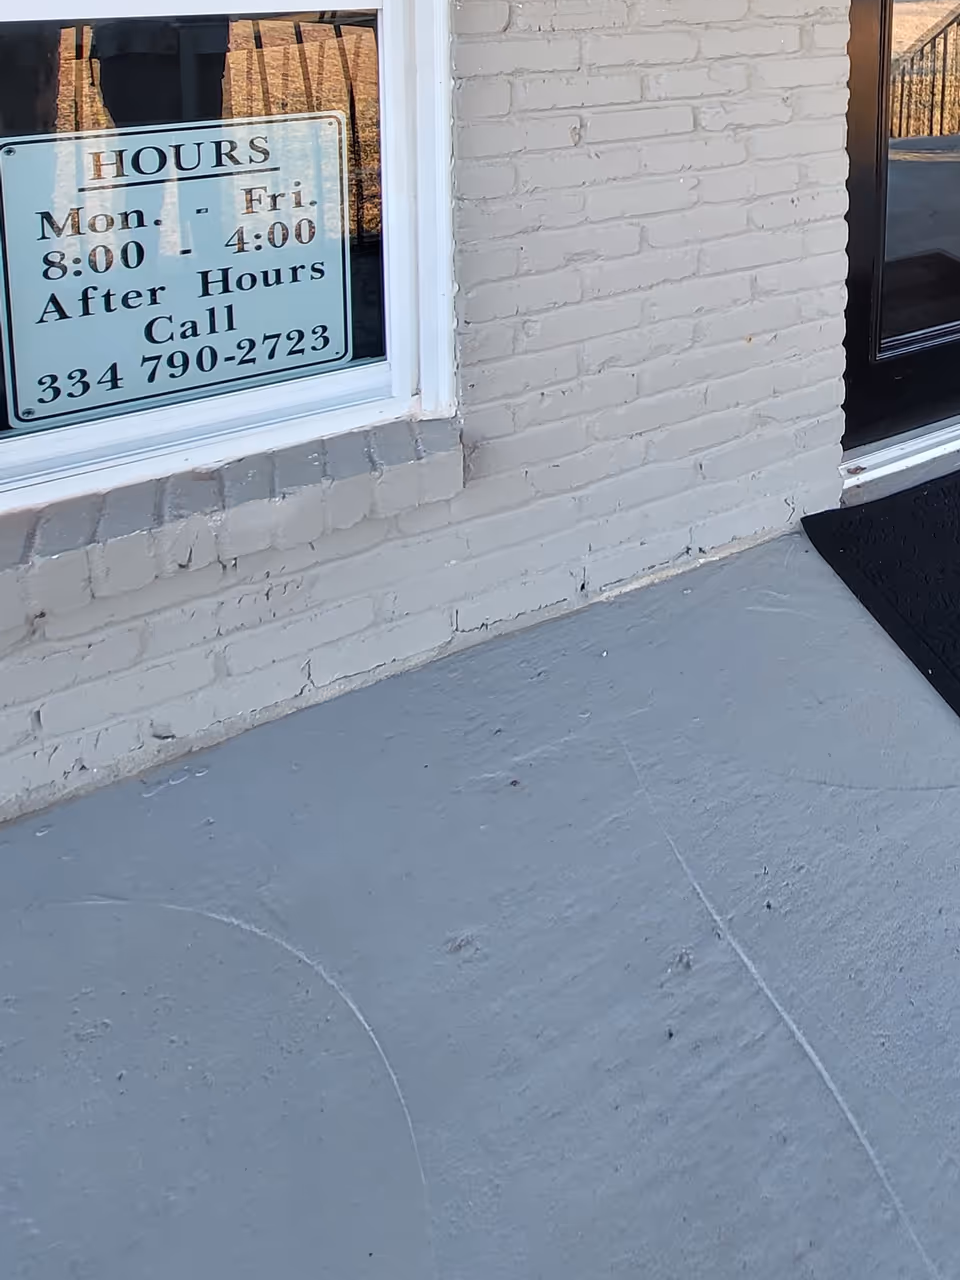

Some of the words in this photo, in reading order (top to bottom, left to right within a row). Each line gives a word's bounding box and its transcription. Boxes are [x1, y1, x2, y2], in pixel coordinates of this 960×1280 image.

[87, 136, 271, 181] HOURS
[35, 206, 162, 241] Mon.
[240, 180, 318, 215] Fri.
[41, 240, 145, 280] 8:00
[225, 218, 317, 254] 4:00
[35, 285, 167, 324] After
[197, 260, 326, 298] Hours
[143, 304, 239, 345] Call
[36, 362, 125, 404] 334
[140, 324, 331, 384] 790-2723
